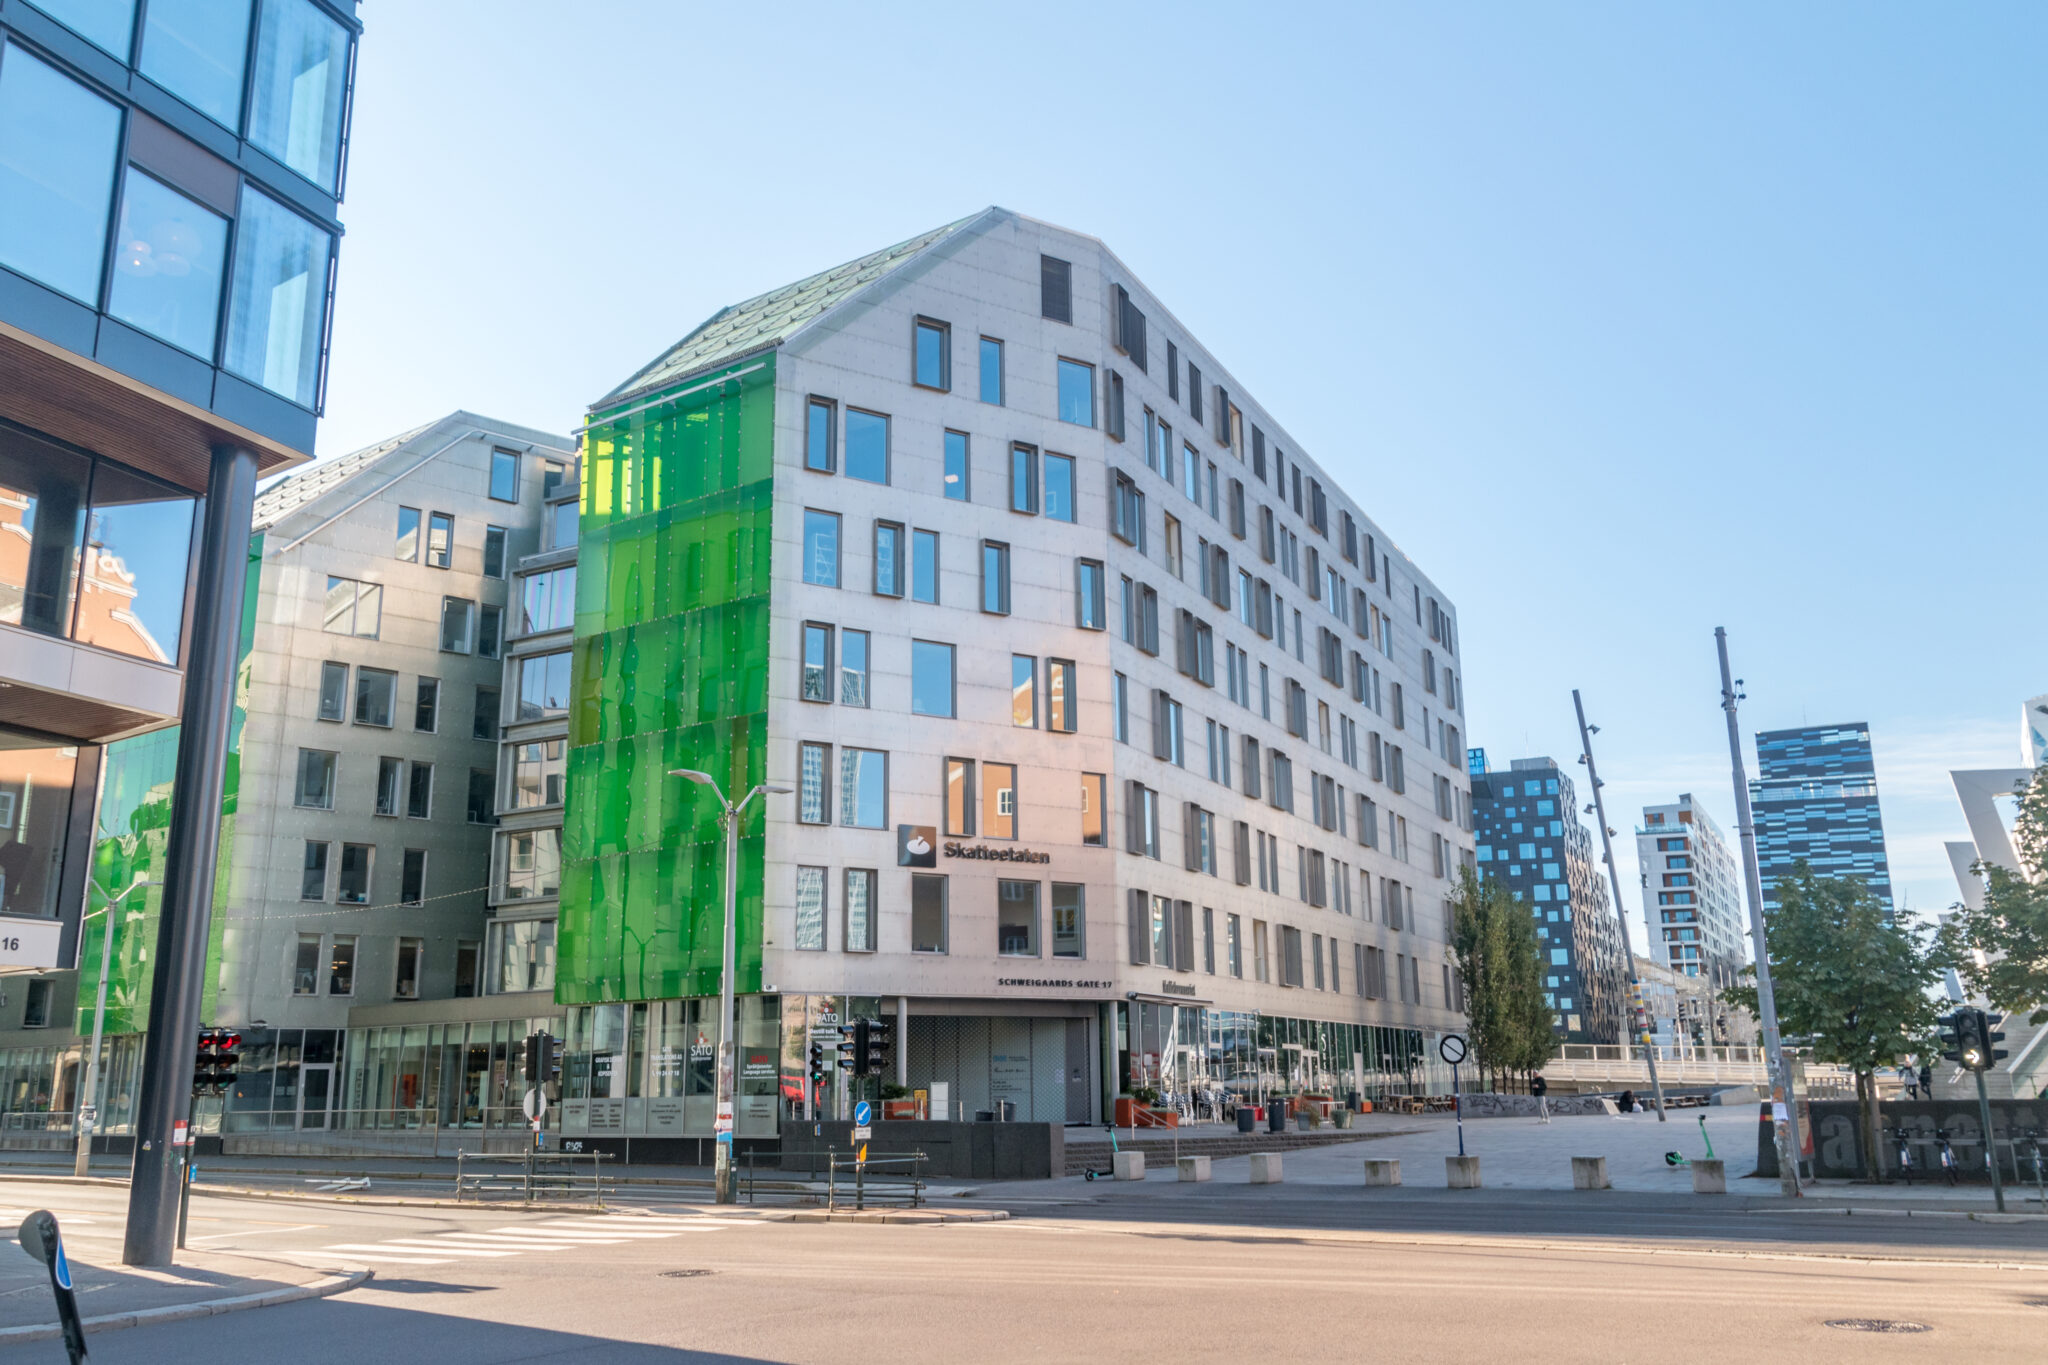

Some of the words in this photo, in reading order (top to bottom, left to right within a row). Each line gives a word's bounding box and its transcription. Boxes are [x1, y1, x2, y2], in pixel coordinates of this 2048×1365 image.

[944, 841, 1050, 864] Skatteetaten
[2, 937, 19, 951] 16
[998, 978, 1073, 987] SCHWEIGAARDS
[1077, 980, 1100, 988] GATE
[1102, 981, 1112, 989] 17
[691, 1045, 713, 1056] SATO
